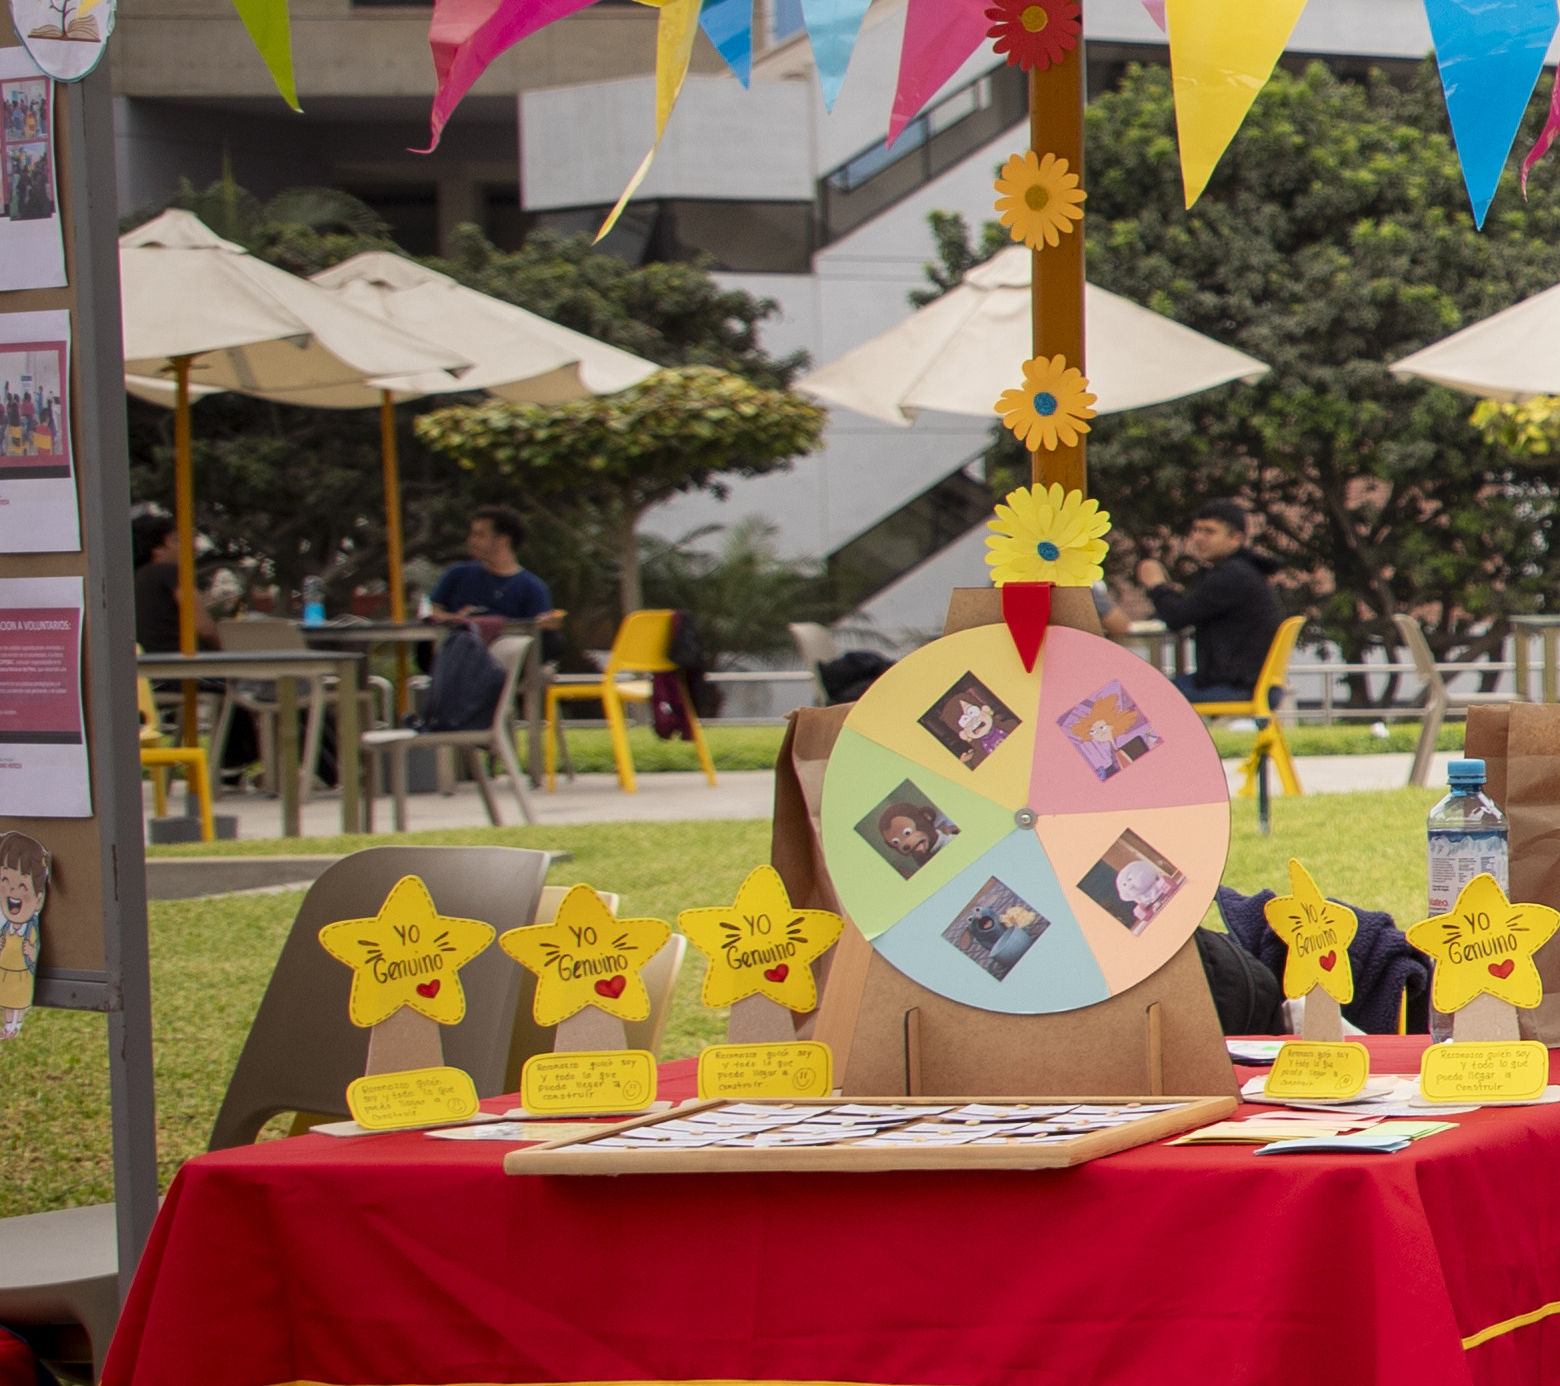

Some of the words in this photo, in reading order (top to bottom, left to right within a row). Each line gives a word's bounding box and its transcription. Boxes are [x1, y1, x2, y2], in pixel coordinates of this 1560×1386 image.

[393, 924, 420, 947] YO
[742, 913, 772, 936] YO
[1464, 912, 1490, 934] YO
[568, 925, 598, 948] YO
[1448, 932, 1518, 965] Genuino
[374, 951, 444, 984] Genuino
[558, 952, 628, 981] Genuino
[726, 941, 796, 970] Genuino
